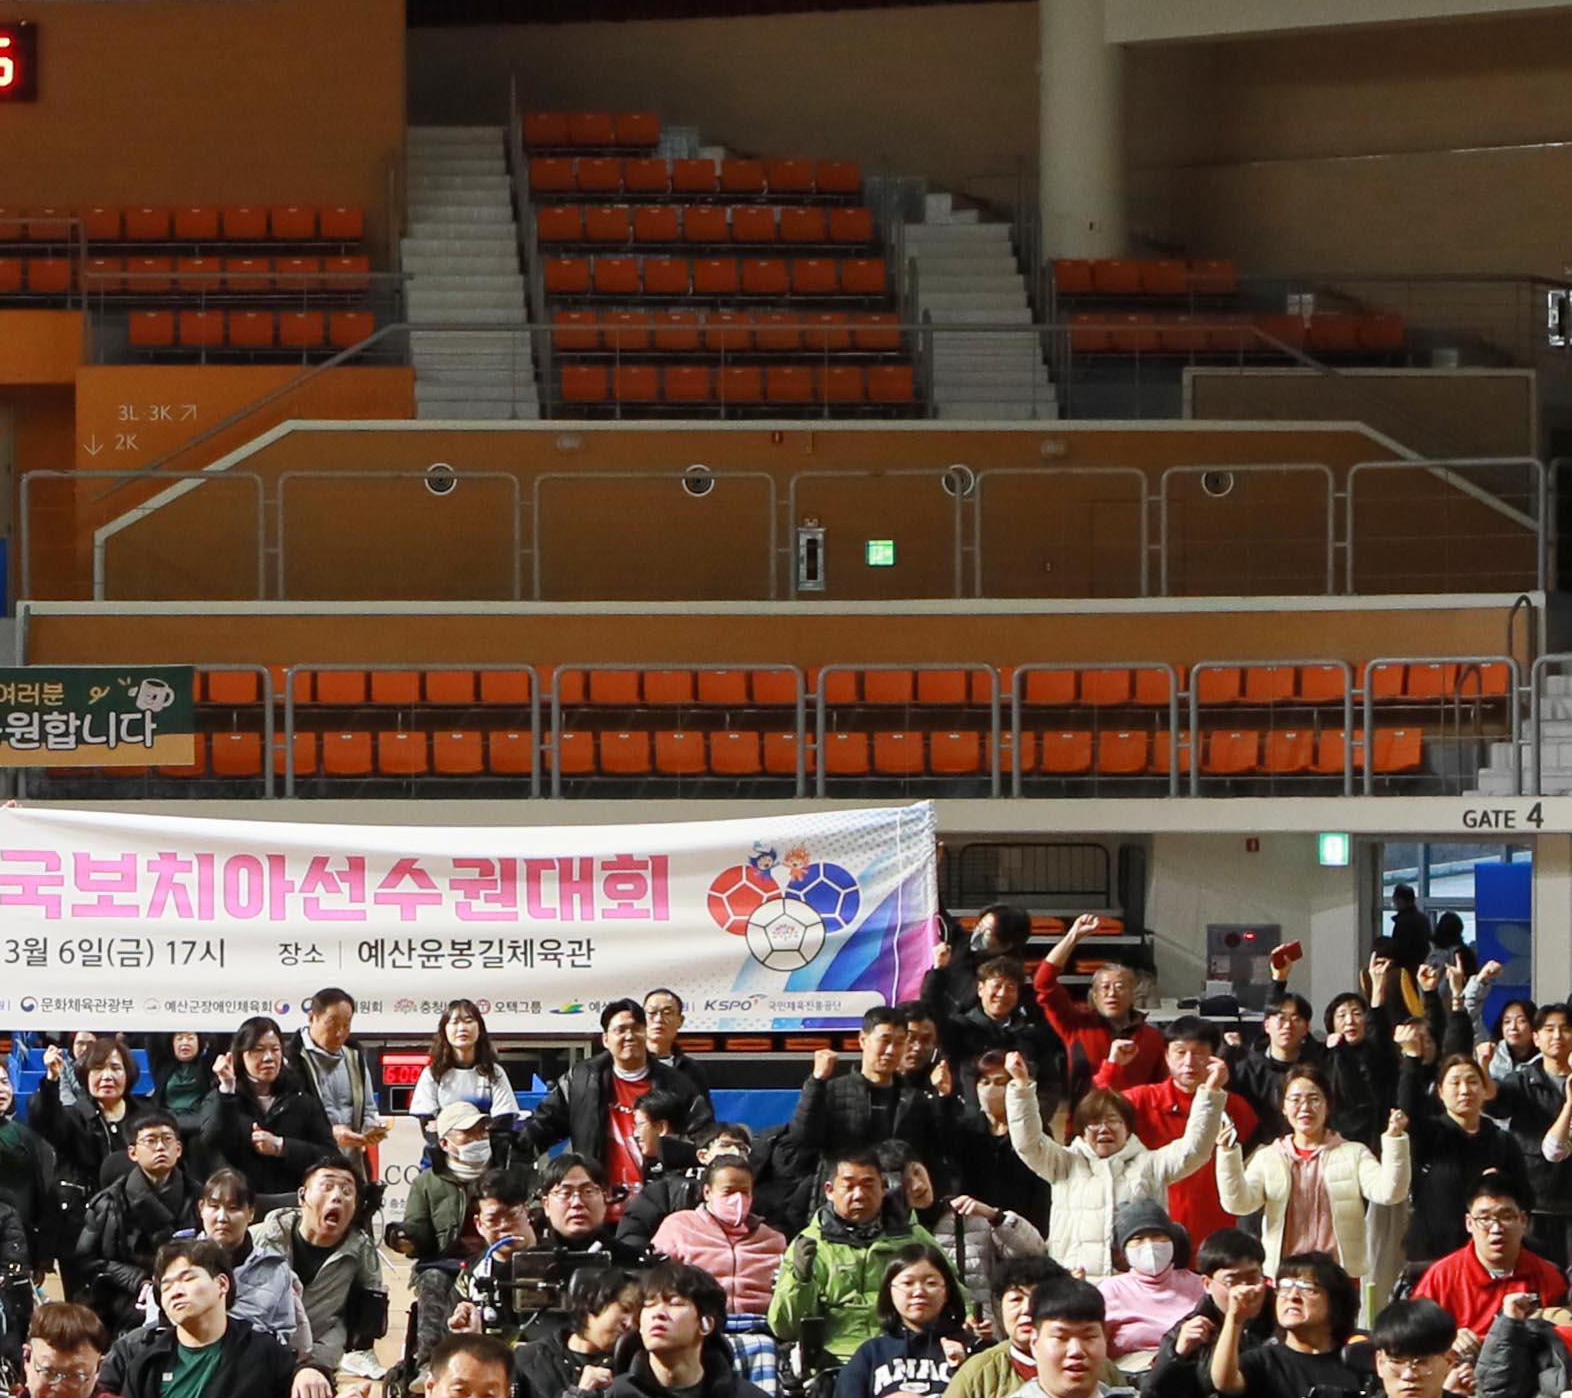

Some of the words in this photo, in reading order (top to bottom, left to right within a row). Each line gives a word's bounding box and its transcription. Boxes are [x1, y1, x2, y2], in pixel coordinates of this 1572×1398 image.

[113, 433, 139, 451] 2K
[1462, 809, 1516, 830] GATE
[1526, 803, 1544, 830] 4
[2, 936, 51, 969] 3월
[58, 936, 156, 969] 6일(금)
[163, 936, 227, 969] 17시
[277, 938, 326, 968] 장소
[356, 937, 596, 970] 예산윤봉길체육관
[40, 998, 135, 1013] 문화체육관광부
[164, 1000, 273, 1014] 예산군장애인체육회
[494, 1000, 542, 1014] 오텍그룹
[704, 999, 752, 1011] KSPO
